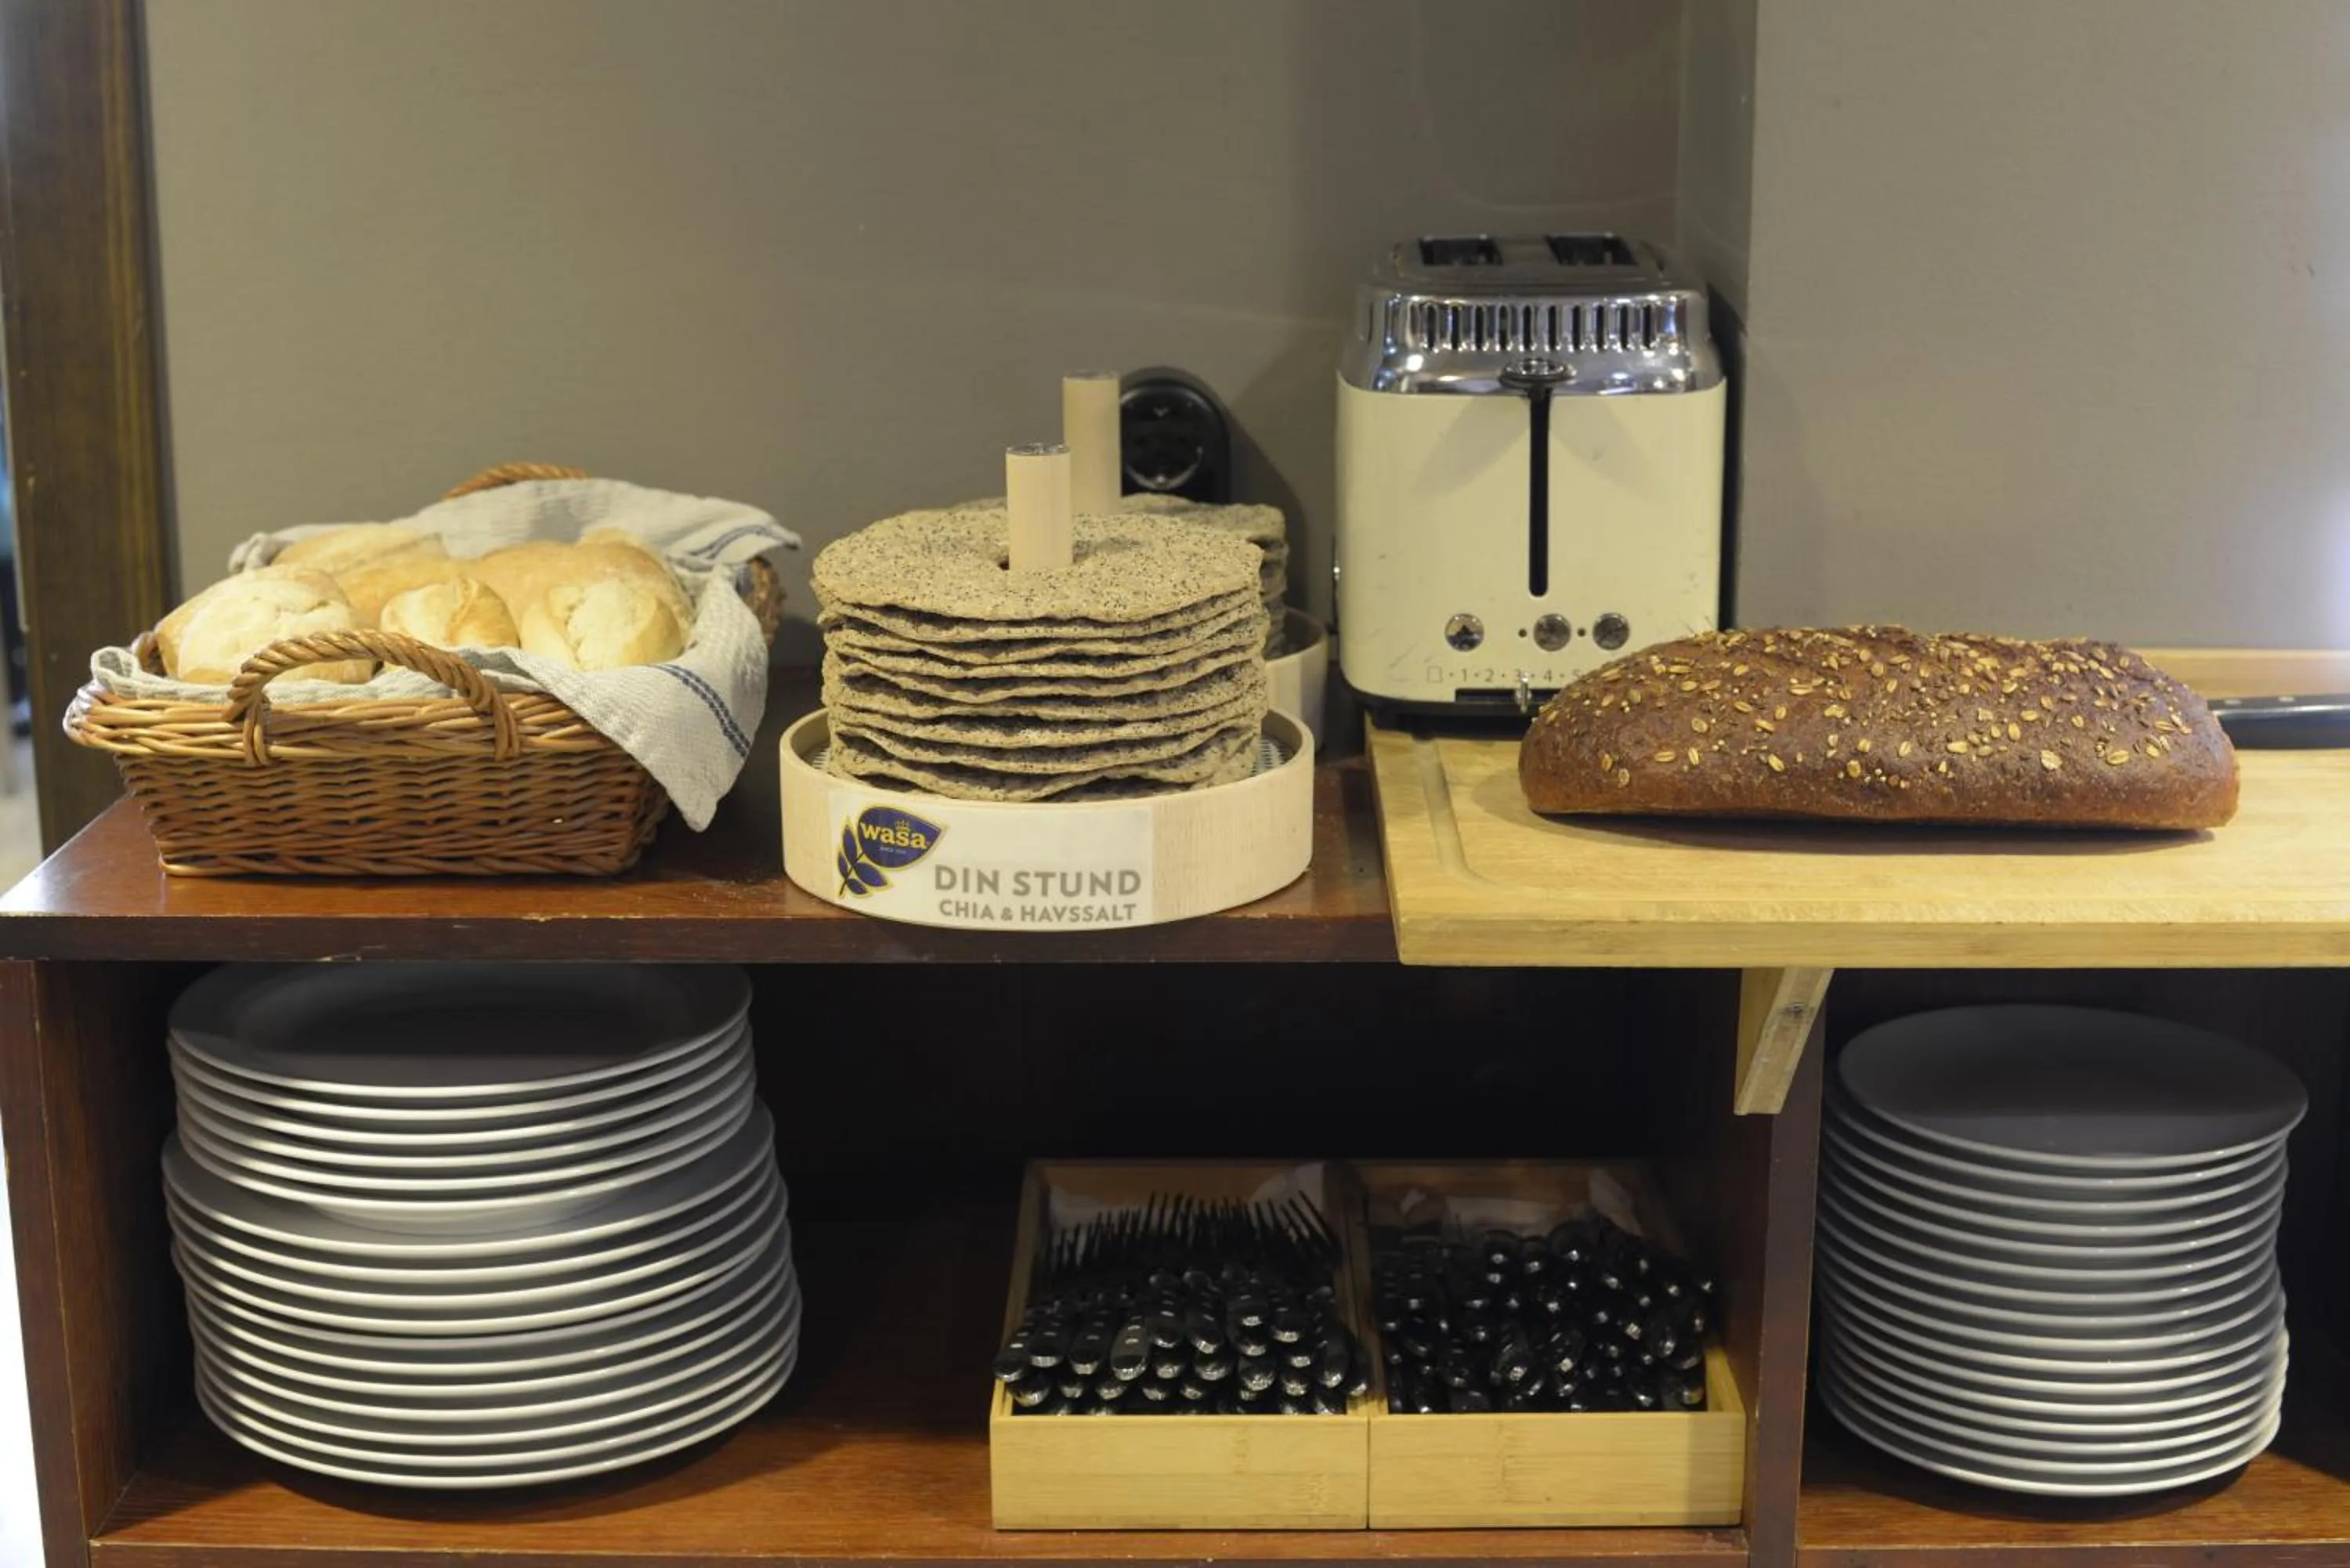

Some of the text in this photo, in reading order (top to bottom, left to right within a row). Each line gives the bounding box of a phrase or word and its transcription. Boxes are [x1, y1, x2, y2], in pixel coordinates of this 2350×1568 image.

[860, 822, 927, 849] wasa
[935, 864, 1141, 897] DIN STUND
[939, 899, 1137, 923] CHIA & HAVSSALT
